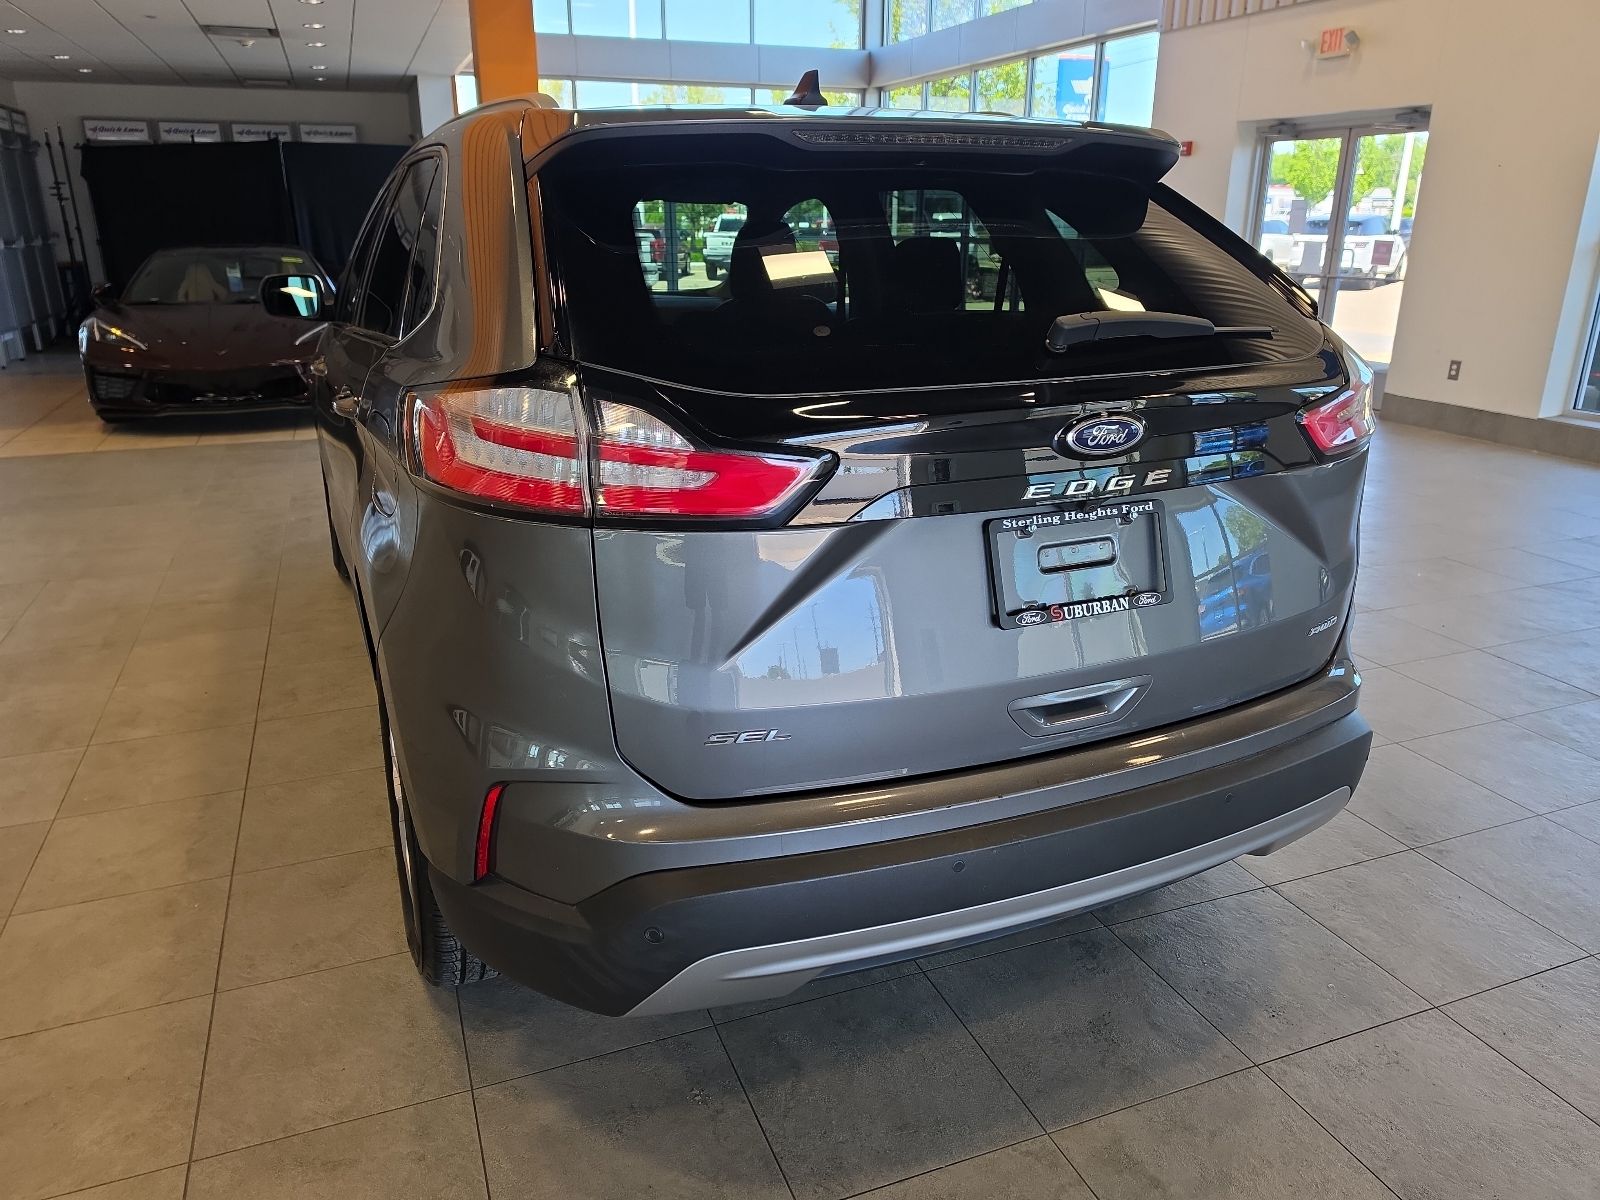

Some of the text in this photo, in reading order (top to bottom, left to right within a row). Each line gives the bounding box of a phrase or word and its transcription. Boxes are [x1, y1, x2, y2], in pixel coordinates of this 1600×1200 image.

[1320, 28, 1345, 54] EXIT
[1087, 424, 1129, 447] Ford
[1021, 468, 1173, 500] EDGE
[1002, 512, 1061, 529] Sterling
[1122, 501, 1154, 514] Ford
[1050, 597, 1130, 622] SUBURBAN
[703, 727, 792, 747] SEL
